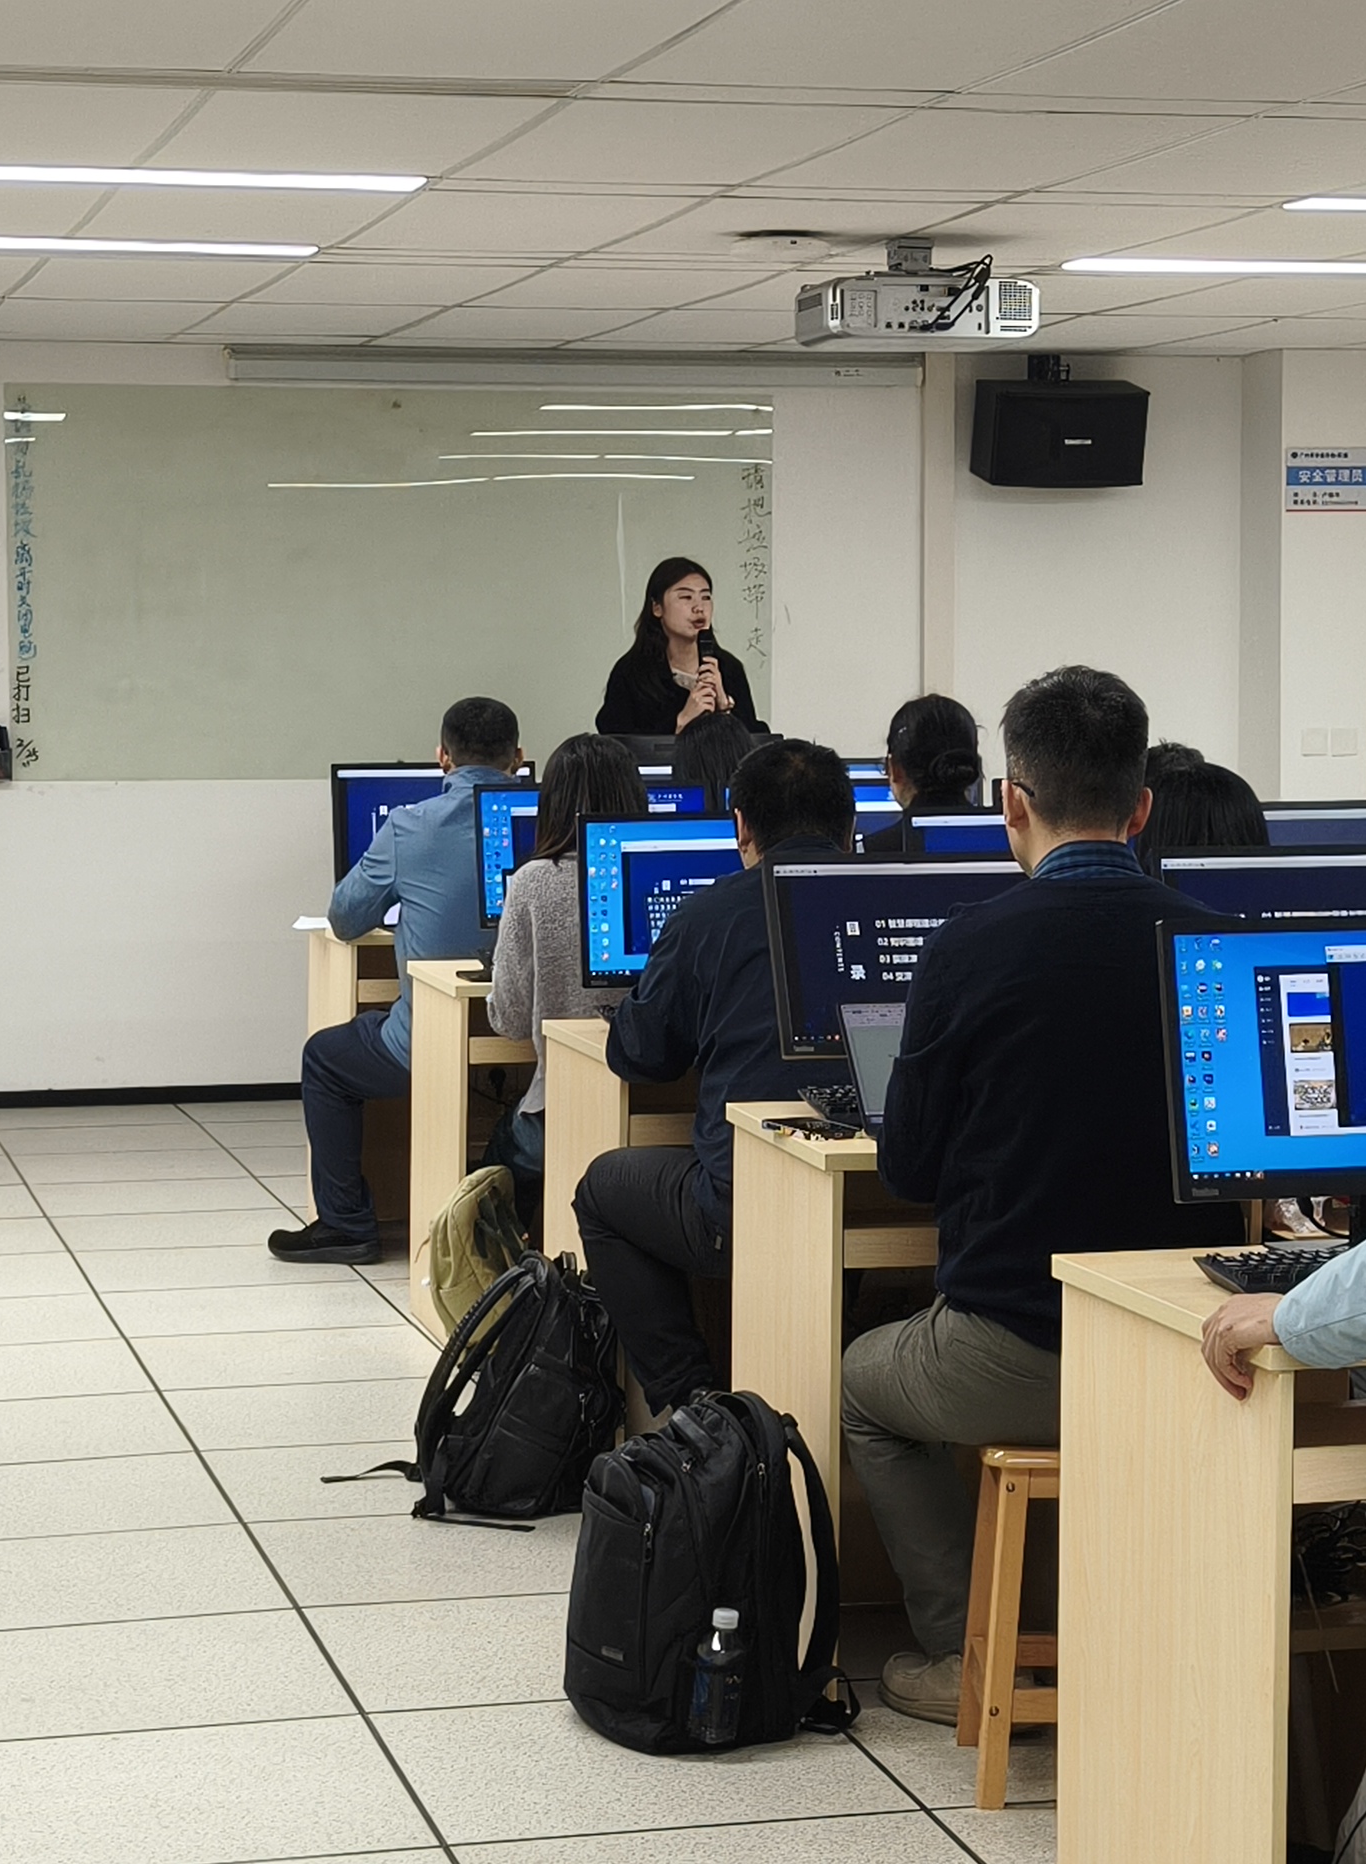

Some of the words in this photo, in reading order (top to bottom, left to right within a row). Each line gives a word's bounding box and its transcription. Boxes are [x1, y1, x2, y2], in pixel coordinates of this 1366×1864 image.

[1298, 469, 1363, 483] 安全管理员
[12, 665, 31, 724] 已打扫
